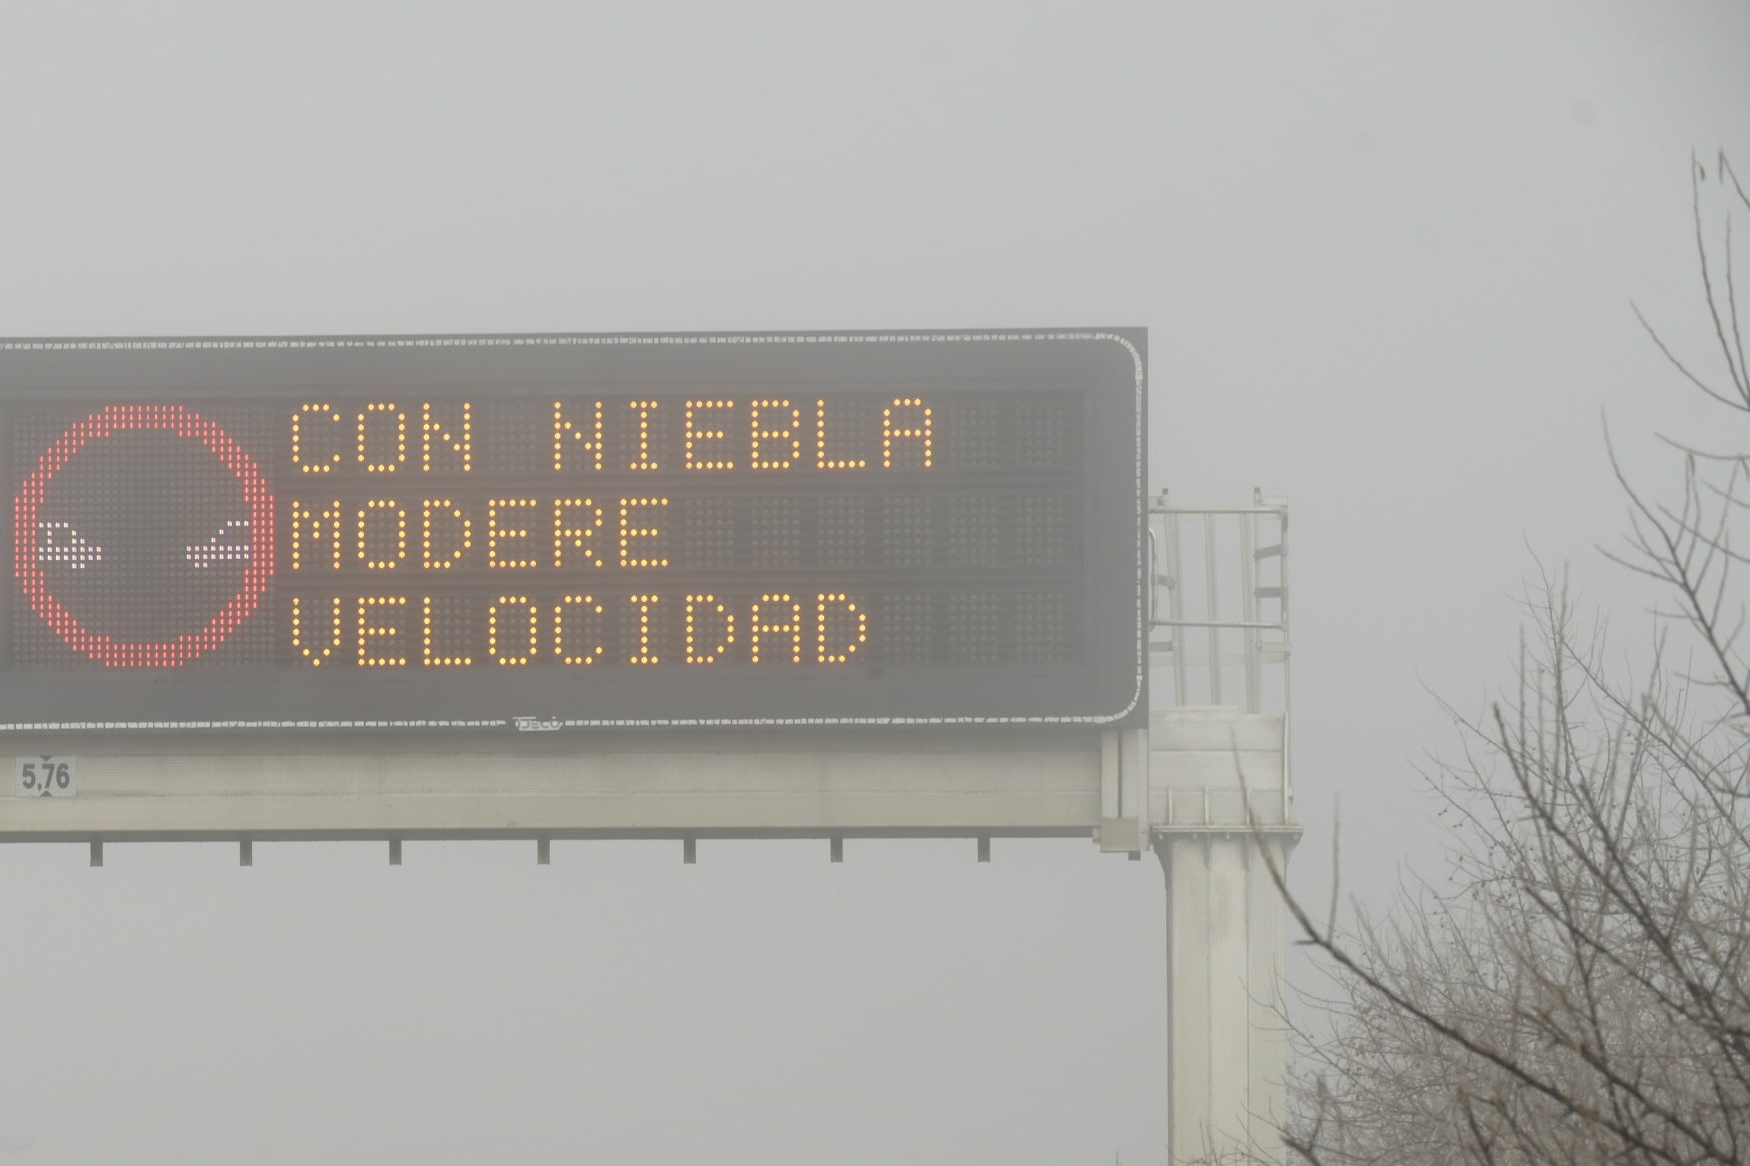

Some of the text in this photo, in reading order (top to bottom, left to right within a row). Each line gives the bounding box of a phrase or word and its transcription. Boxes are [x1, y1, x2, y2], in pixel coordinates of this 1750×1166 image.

[291, 397, 934, 474] CON NIEBLA
[290, 496, 670, 571] MODERE
[291, 592, 868, 668] VELOCIDAD
[22, 763, 70, 791] 5,76
